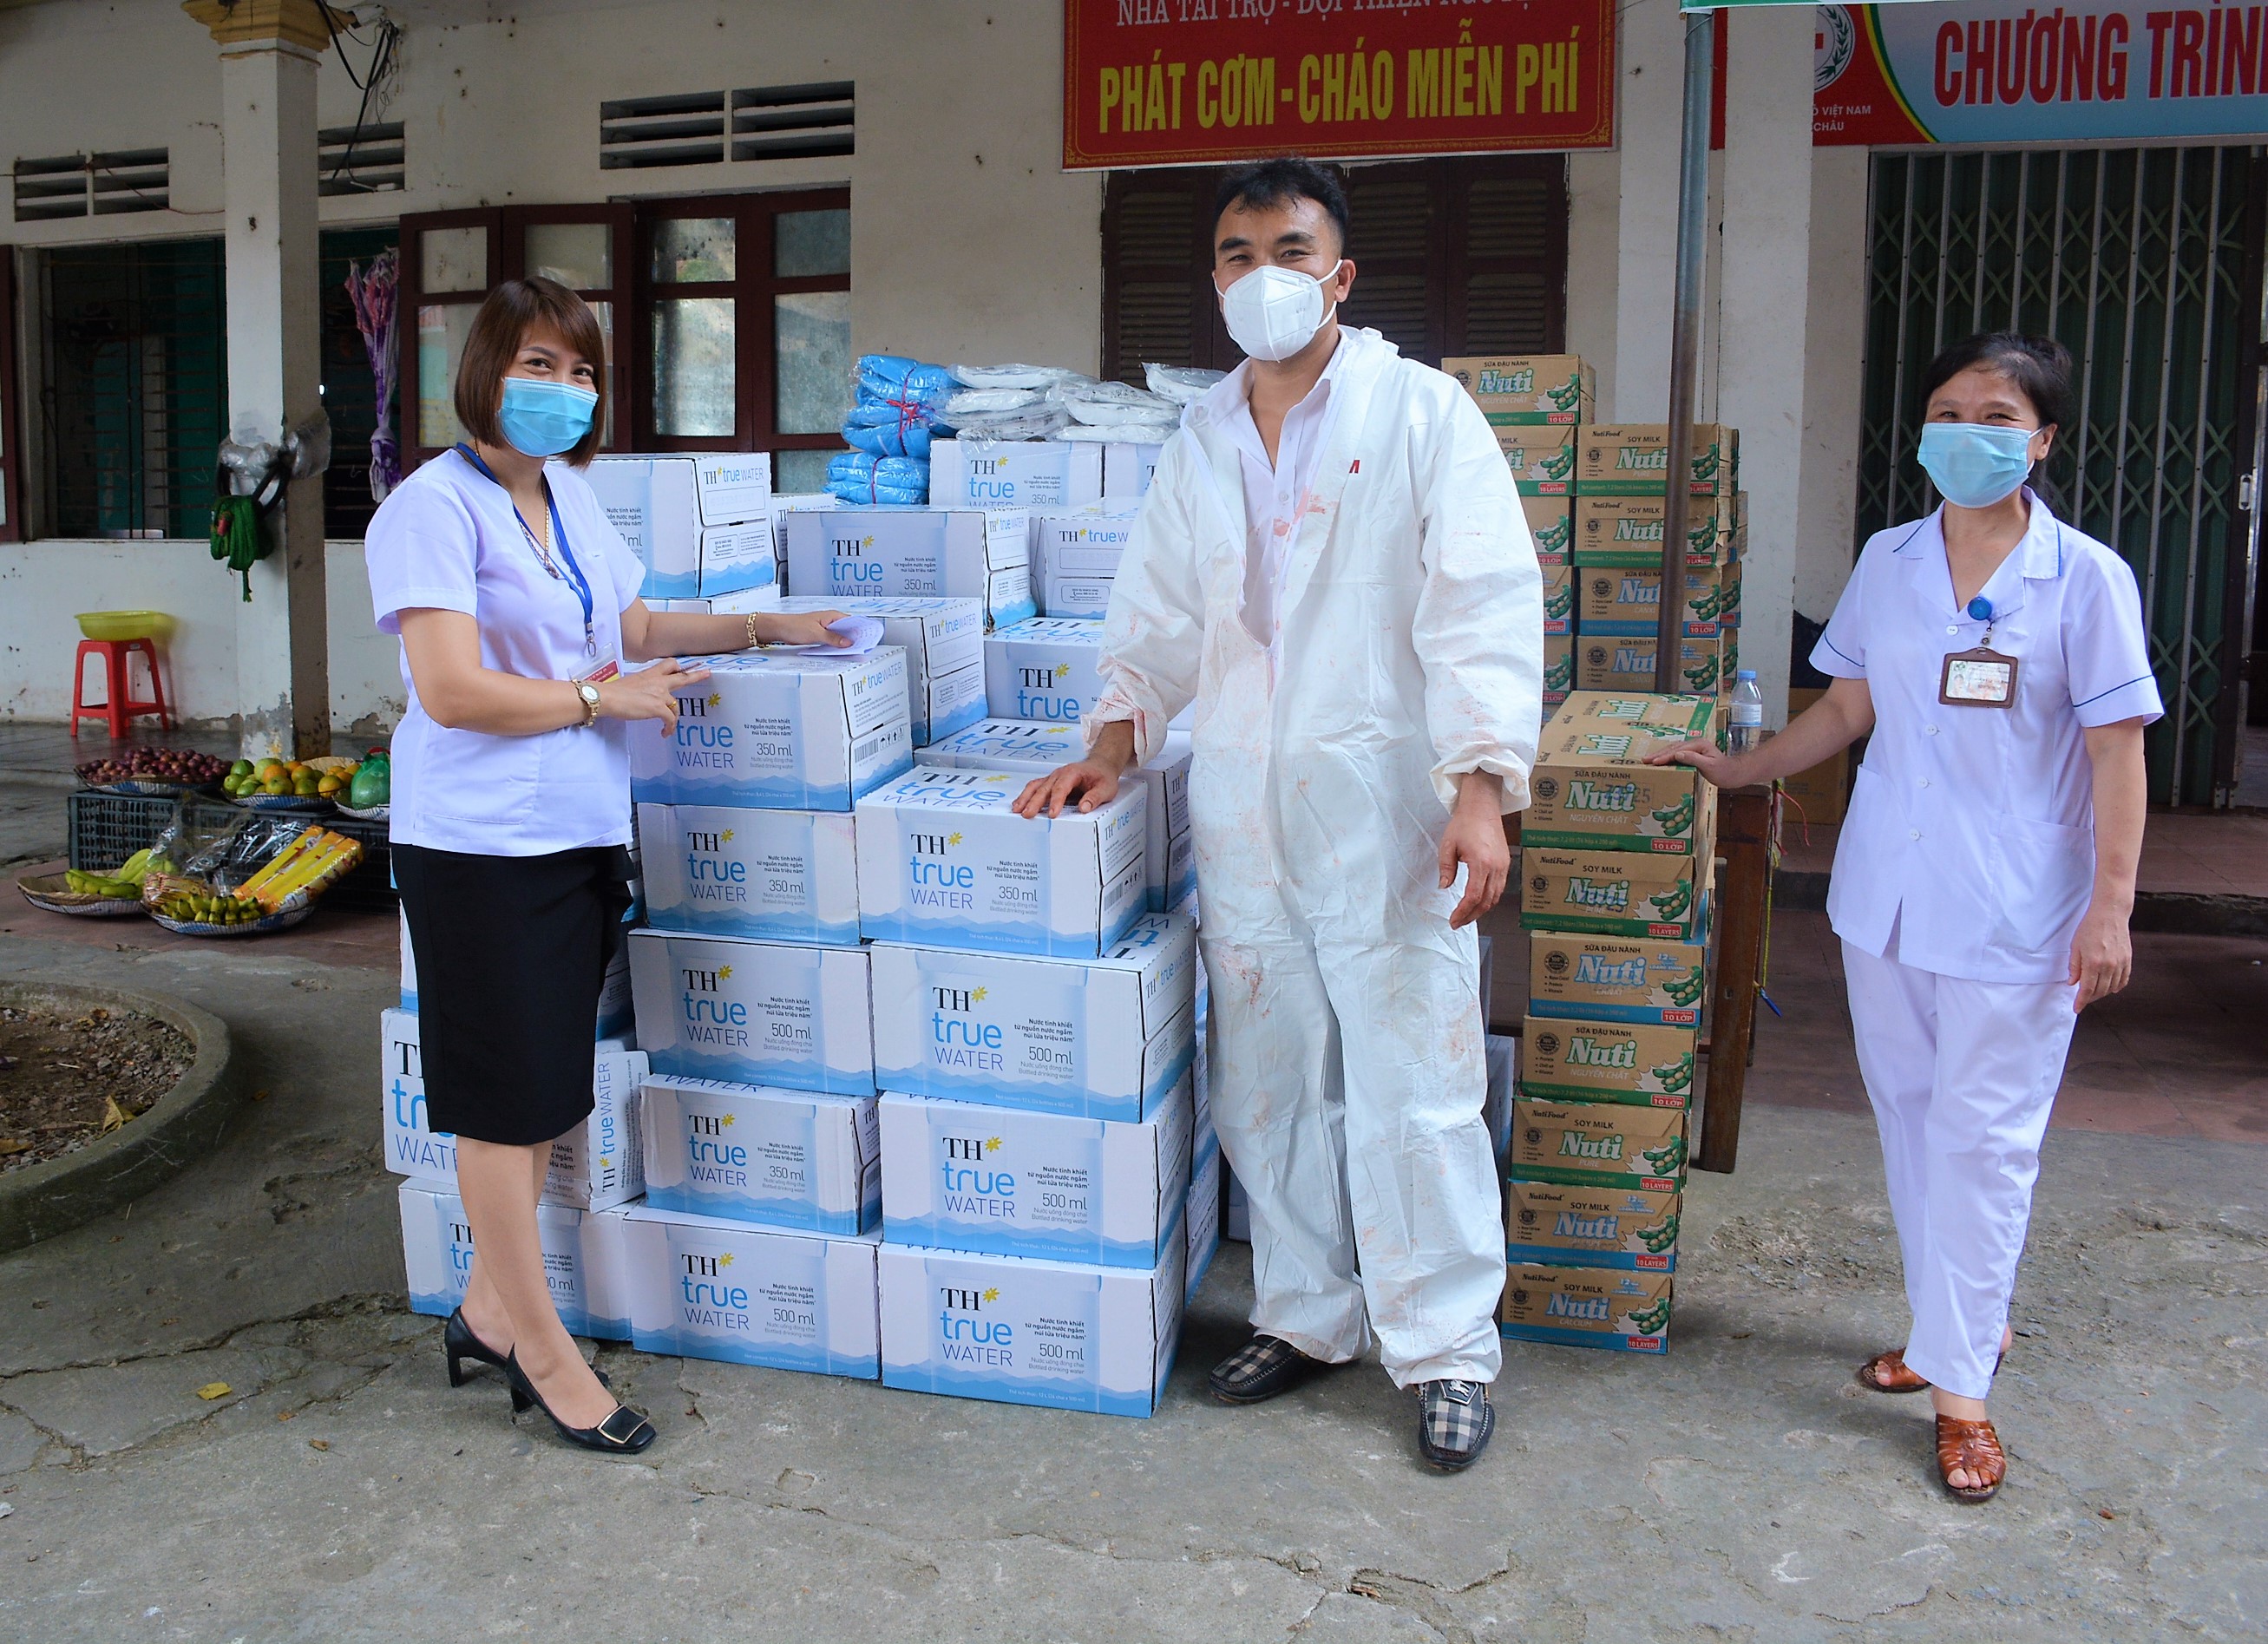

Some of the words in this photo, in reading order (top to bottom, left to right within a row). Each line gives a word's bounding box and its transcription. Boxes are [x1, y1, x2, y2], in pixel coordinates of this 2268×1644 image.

[1933, 9, 2129, 107] CHƯƠNG
[2147, 0, 2268, 99] TRÌN
[1099, 49, 1186, 133] PHÁT
[1406, 18, 1502, 119] MIỄN
[1517, 26, 1580, 114] PHÍ
[1822, 104, 1843, 118] VIỆT
[1846, 106, 1871, 115] NAM
[1813, 120, 1845, 131] CHÂU
[1477, 369, 1533, 394] Nuti
[704, 471, 717, 484] TH
[723, 468, 739, 482] true
[741, 468, 764, 481] WATER
[971, 460, 996, 475] TH
[969, 478, 1014, 498] true
[1032, 495, 1046, 504] 350
[1048, 495, 1059, 504] ml
[832, 540, 861, 556] TH
[831, 558, 883, 582] true
[832, 585, 882, 597] WATER
[904, 580, 921, 590] 350
[923, 580, 936, 591] ml
[852, 681, 863, 696] TH
[868, 672, 882, 688] true
[882, 662, 902, 679] WATER
[1019, 668, 1053, 688] TH
[676, 698, 707, 717] TH
[1017, 690, 1079, 719] true
[677, 720, 733, 748] true
[982, 724, 1039, 737] TH
[757, 743, 776, 756] 350
[778, 744, 792, 756] ml
[941, 745, 1054, 759] WATER
[955, 733, 1069, 751] true
[677, 751, 734, 768] WATER
[922, 772, 979, 785] TH
[883, 795, 992, 809] WATER
[895, 782, 1006, 801] true
[1564, 781, 1636, 811] Nuti
[687, 832, 720, 852] TH
[911, 835, 947, 855] TH
[688, 854, 744, 882] true
[1540, 856, 1576, 865] NutiFood
[910, 856, 973, 887] true
[691, 884, 746, 901] WATER
[770, 880, 787, 893] 350
[790, 882, 804, 894] ml
[1000, 887, 1019, 900] 350
[1022, 889, 1038, 901] ml
[1564, 877, 1629, 905] Nuti
[911, 889, 973, 909] WATER
[683, 969, 718, 992] TH
[1575, 954, 1646, 986] Nuti
[683, 992, 746, 1025] true
[933, 987, 971, 1012] TH
[686, 1025, 748, 1047] WATER
[772, 1023, 792, 1038] 500
[796, 1027, 812, 1039] ml
[932, 1012, 1001, 1049] true
[935, 1046, 1003, 1071] WATER
[1029, 1046, 1052, 1062] 500
[1056, 1051, 1073, 1064] ml
[1565, 1037, 1636, 1068] Nuti
[598, 1063, 613, 1116] WATER
[1531, 1110, 1569, 1119] NutiFood
[600, 1117, 615, 1155] true
[689, 1115, 721, 1136] TH
[689, 1136, 746, 1166] true
[943, 1137, 983, 1161] TH
[1558, 1130, 1623, 1160] Nuti
[602, 1168, 615, 1192] TH
[691, 1165, 746, 1187] WATER
[770, 1166, 788, 1179] 350
[790, 1169, 804, 1181] ml
[942, 1162, 1014, 1195] true
[945, 1195, 1015, 1217] WATER
[1042, 1193, 1065, 1208] 500
[1069, 1196, 1087, 1210] ml
[1529, 1192, 1564, 1201] NutiFood
[1553, 1211, 1618, 1239] Nuti
[682, 1254, 718, 1277] TH
[1523, 1274, 1558, 1282] NutiFood
[682, 1276, 747, 1309] true
[941, 1287, 981, 1311] TH
[774, 1308, 795, 1322] 500
[799, 1313, 816, 1325] ml
[1545, 1292, 1610, 1320] Nuti
[685, 1307, 750, 1330] WATER
[941, 1311, 1012, 1346] true
[942, 1344, 1013, 1366] WATER
[1039, 1343, 1063, 1358] 500
[1066, 1348, 1084, 1360] ml
